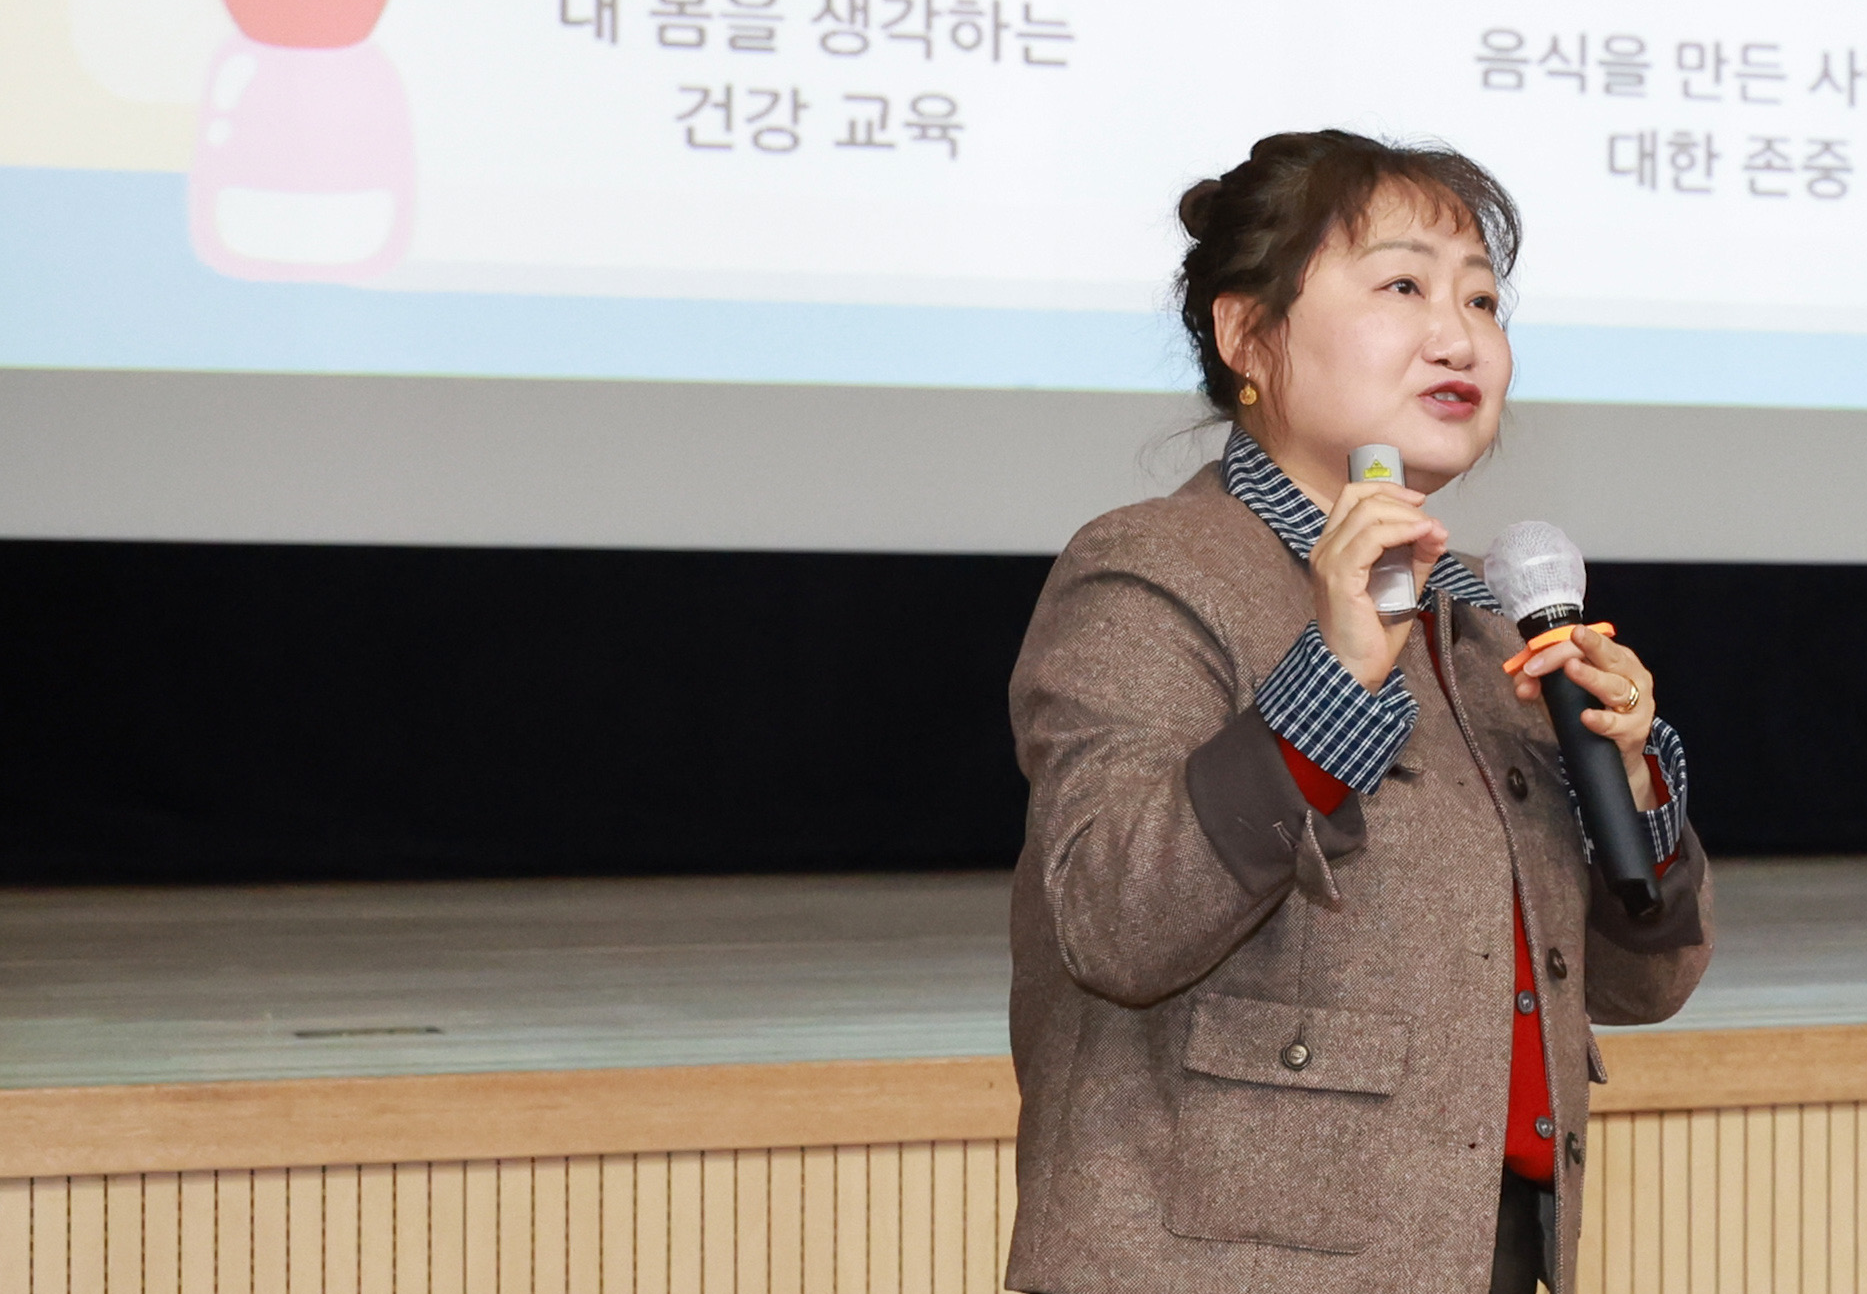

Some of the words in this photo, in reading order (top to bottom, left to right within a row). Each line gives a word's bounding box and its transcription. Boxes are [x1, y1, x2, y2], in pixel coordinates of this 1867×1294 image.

[1475, 28, 1651, 96] 음식을
[1676, 41, 1786, 103] 만든
[676, 83, 809, 154] 건강
[834, 92, 964, 159] 교육
[1608, 131, 1719, 193] 대한
[1743, 137, 1852, 199] 존중
